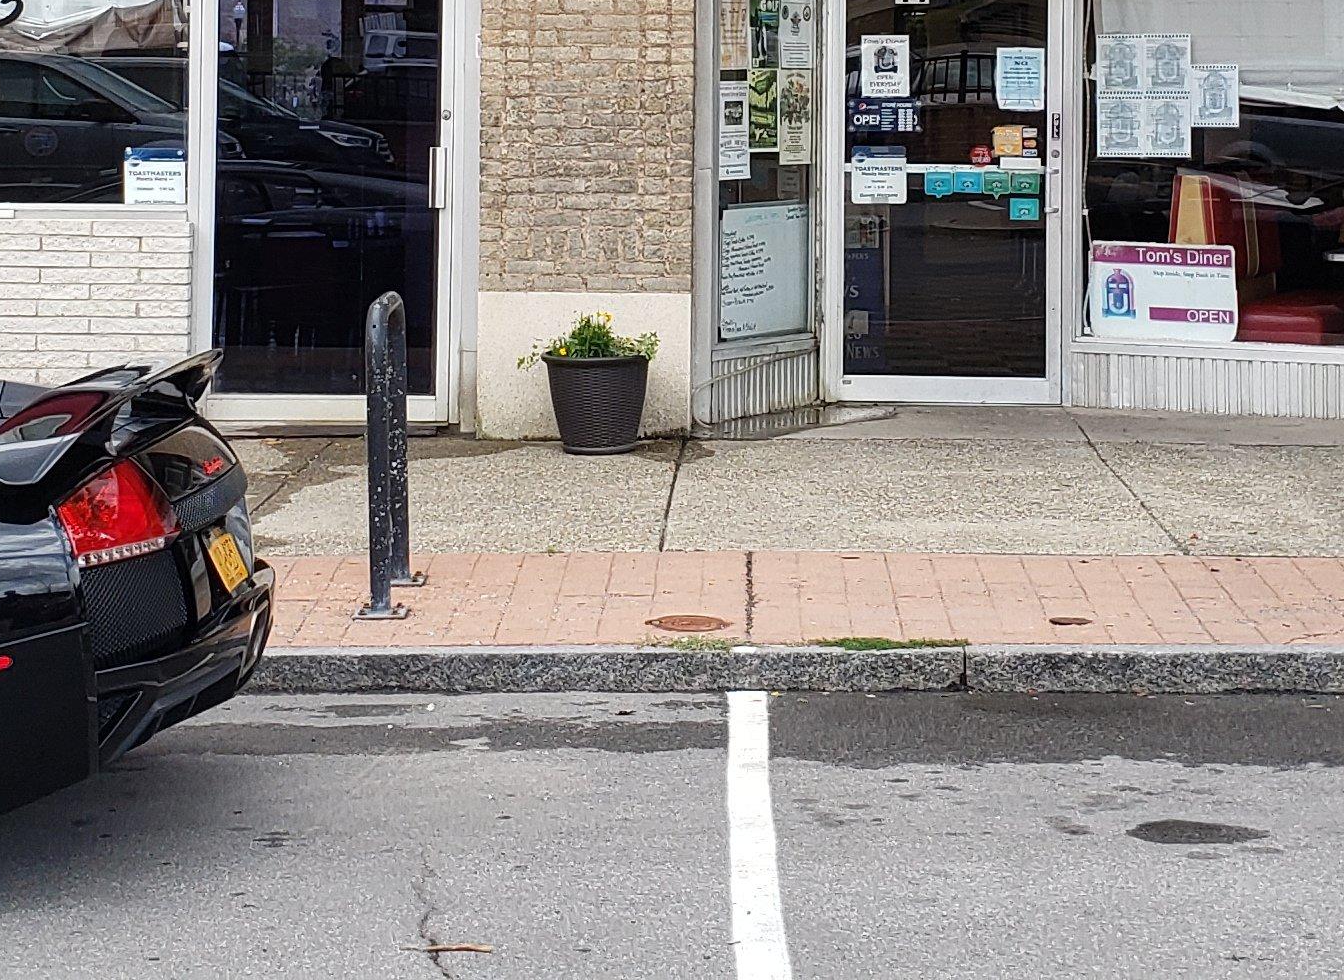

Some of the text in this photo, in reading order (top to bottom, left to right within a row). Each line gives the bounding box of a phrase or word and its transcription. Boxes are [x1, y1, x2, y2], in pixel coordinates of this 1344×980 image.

[1136, 248, 1231, 265] Tom's Diner
[1187, 309, 1230, 324] OPEN
